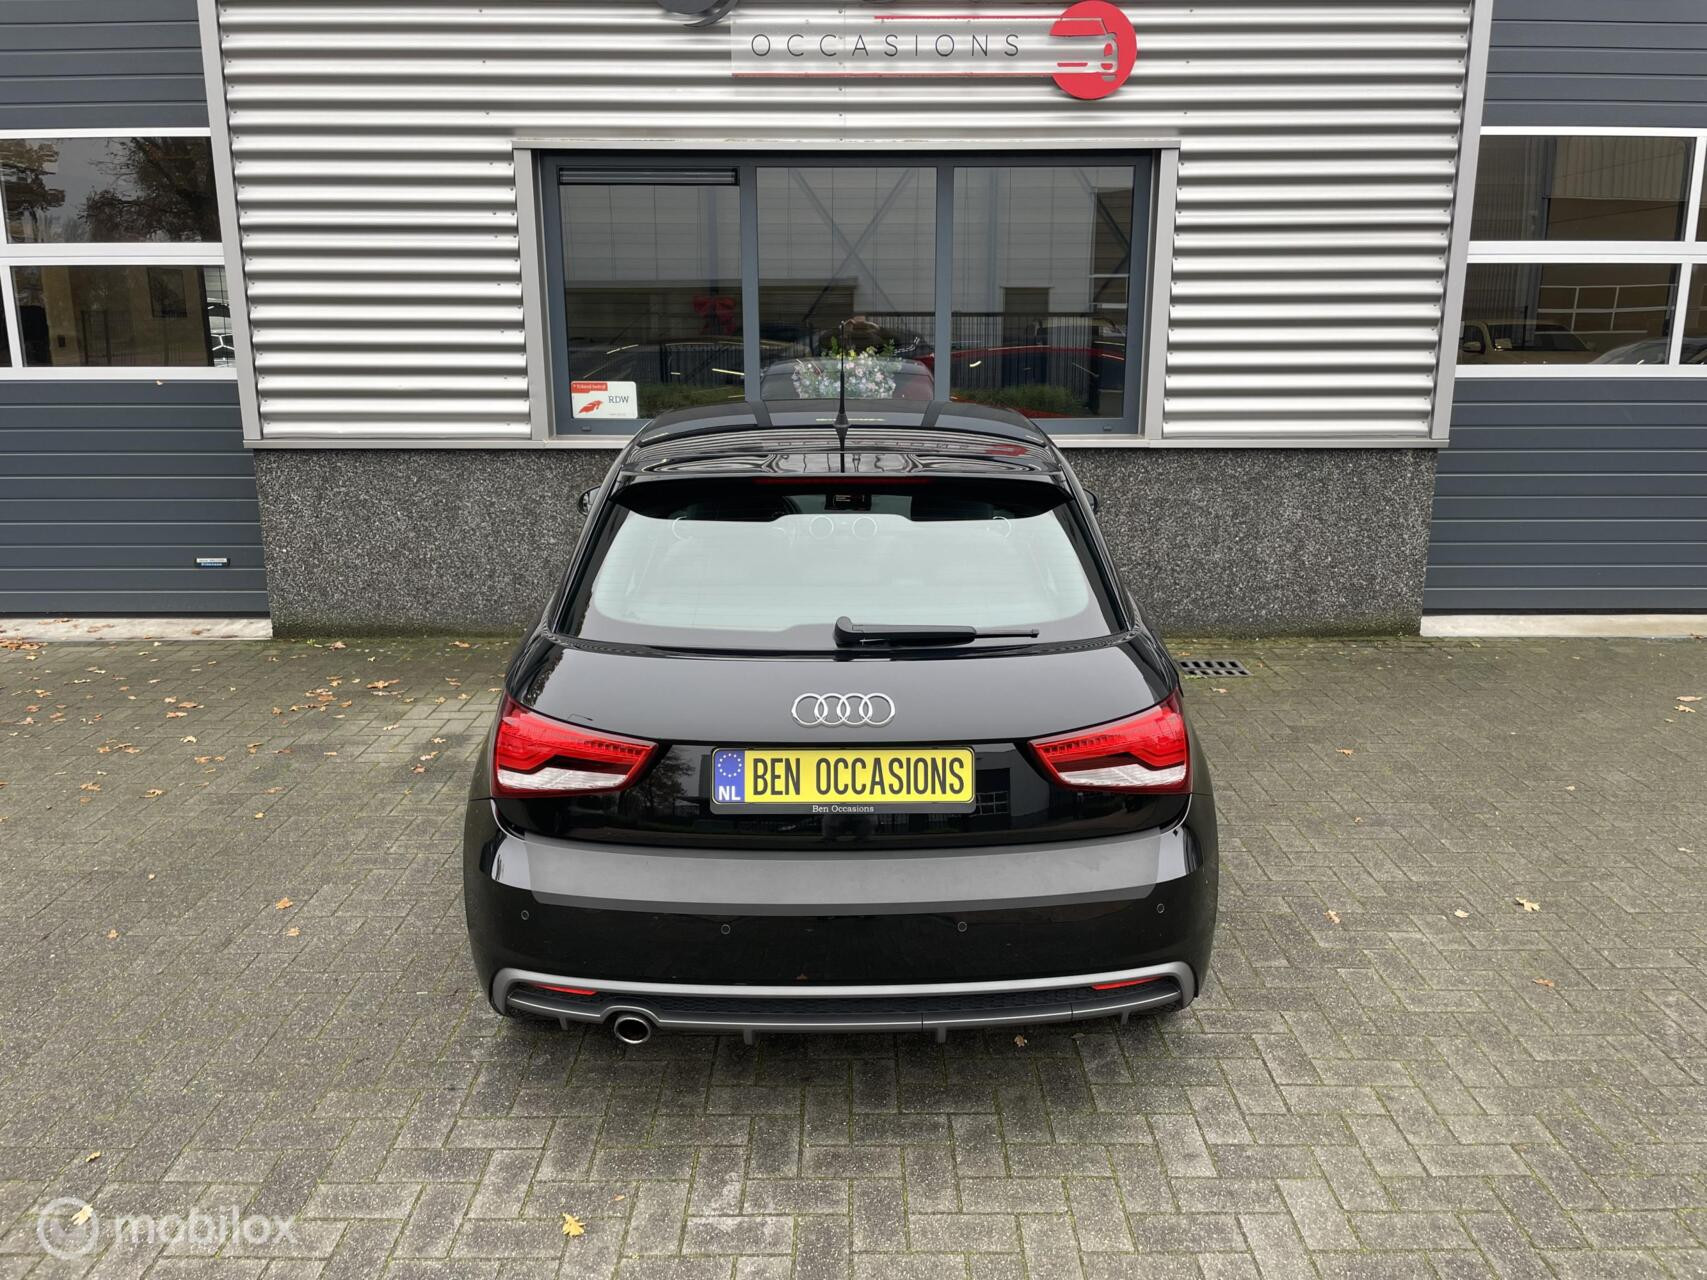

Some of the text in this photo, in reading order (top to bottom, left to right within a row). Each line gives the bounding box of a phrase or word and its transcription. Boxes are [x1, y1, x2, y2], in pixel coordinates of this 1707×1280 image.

[750, 33, 1020, 57] OCCASIONS
[608, 395, 629, 404] RDW
[753, 757, 964, 795] BEN OCCASIONS
[718, 786, 741, 801] NL
[812, 804, 874, 813] Ben Occasions
